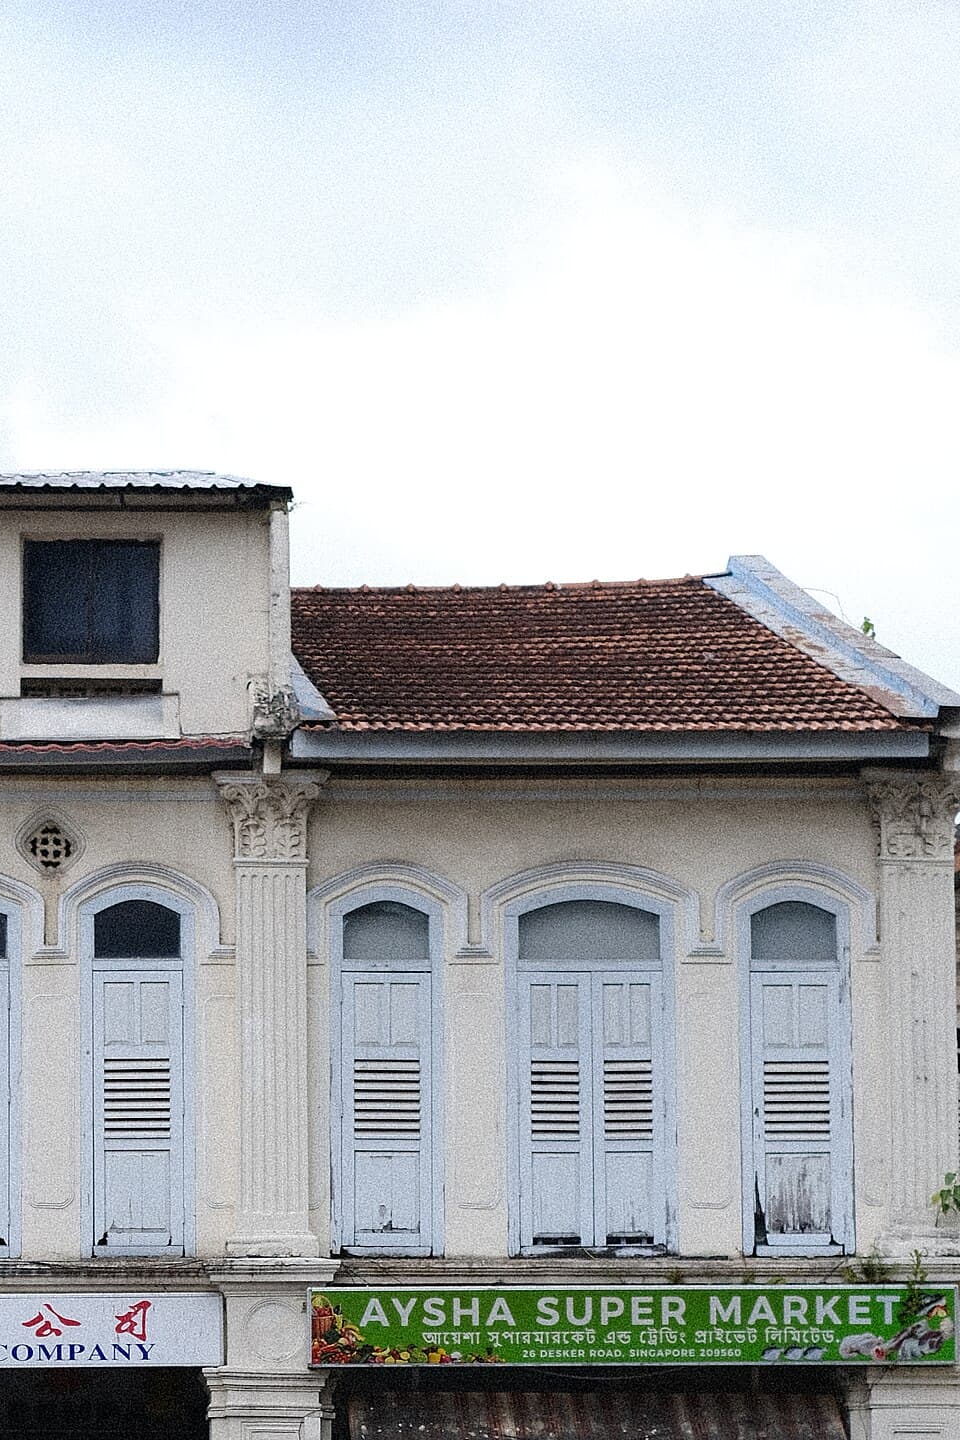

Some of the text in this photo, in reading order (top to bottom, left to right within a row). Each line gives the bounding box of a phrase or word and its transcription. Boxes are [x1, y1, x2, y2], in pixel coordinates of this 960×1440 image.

[359, 1295, 900, 1328] AYSHA SUPER MARKET
[422, 1330, 481, 1345] আয়েশা
[488, 1327, 596, 1347] সুপারমারকেট
[603, 1330, 632, 1345] এন্ড
[639, 1327, 686, 1346] ট্রেডিং
[694, 1327, 758, 1344] প্রাইভেট
[522, 1350, 536, 1358] 26
[540, 1350, 586, 1358] DESKER
[629, 1349, 695, 1358] SINGAPORE
[700, 1348, 741, 1357] 209560
